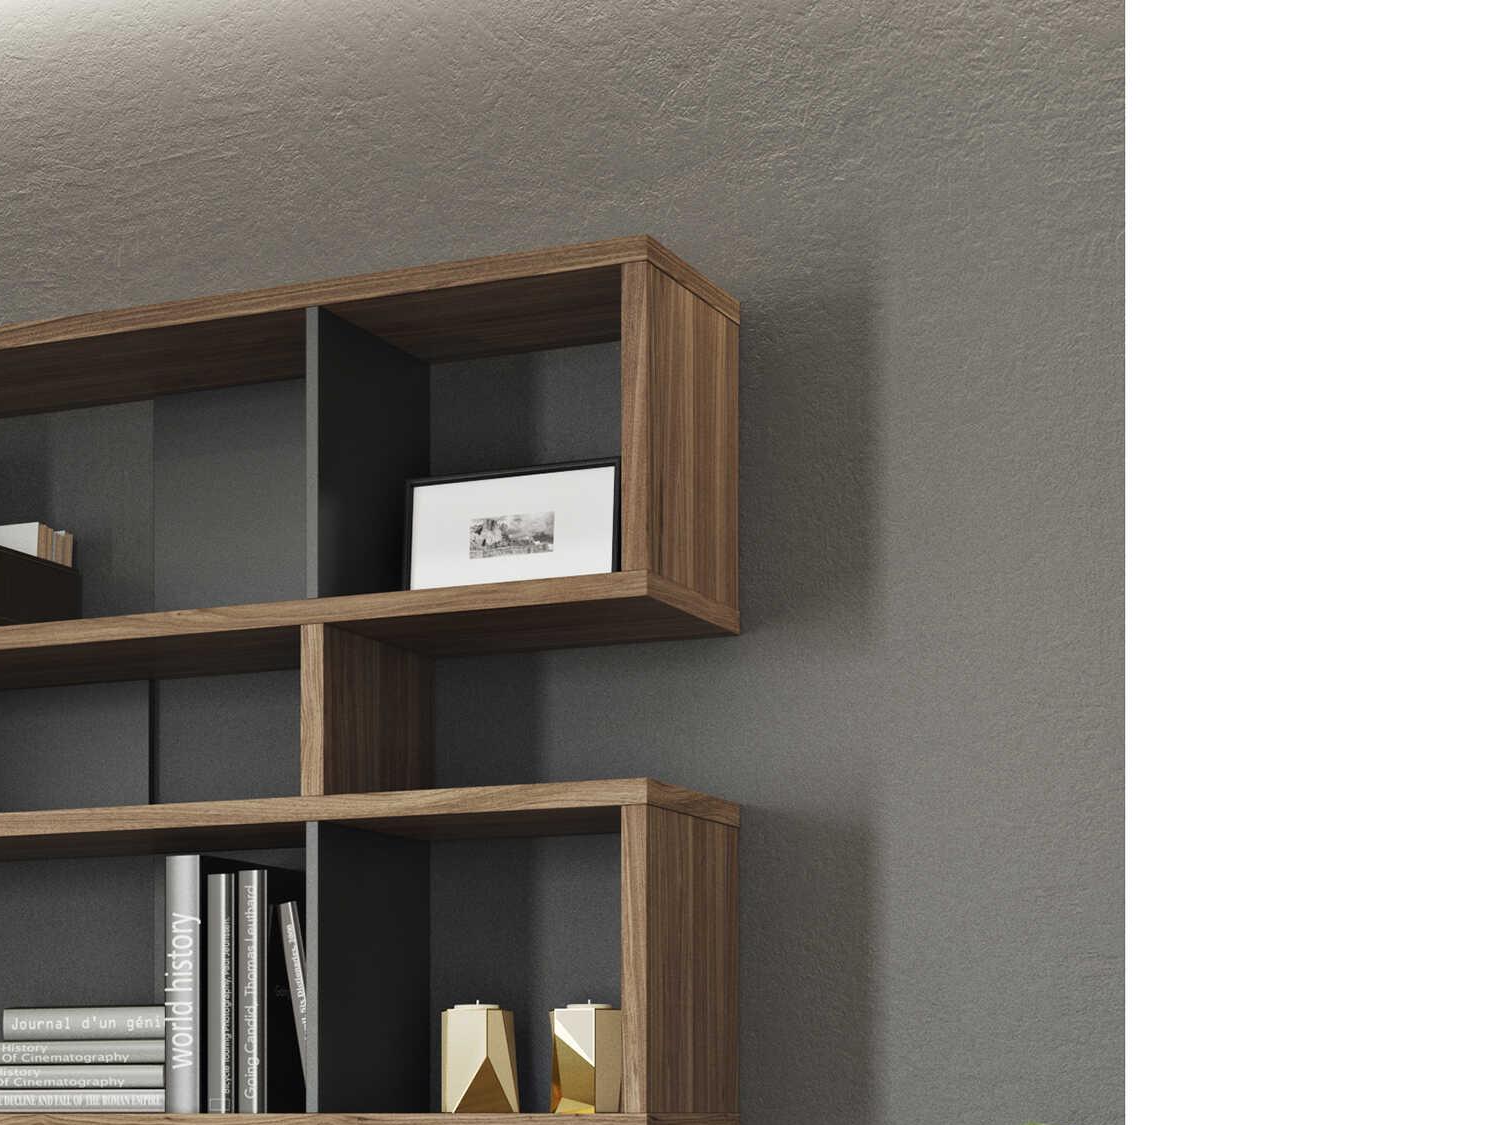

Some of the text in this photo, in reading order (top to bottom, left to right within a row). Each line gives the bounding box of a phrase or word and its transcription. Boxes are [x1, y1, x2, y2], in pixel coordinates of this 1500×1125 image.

[244, 885, 257, 942] Leuthard
[244, 946, 257, 996] Thomas
[164, 912, 202, 1069] world history
[12, 1016, 162, 1031] Journal d'un géni
[2, 1043, 48, 1054] History
[2, 1052, 130, 1064] Of Cinematography
[13, 1076, 125, 1088] Cinematography
[244, 1057, 260, 1100] Going
